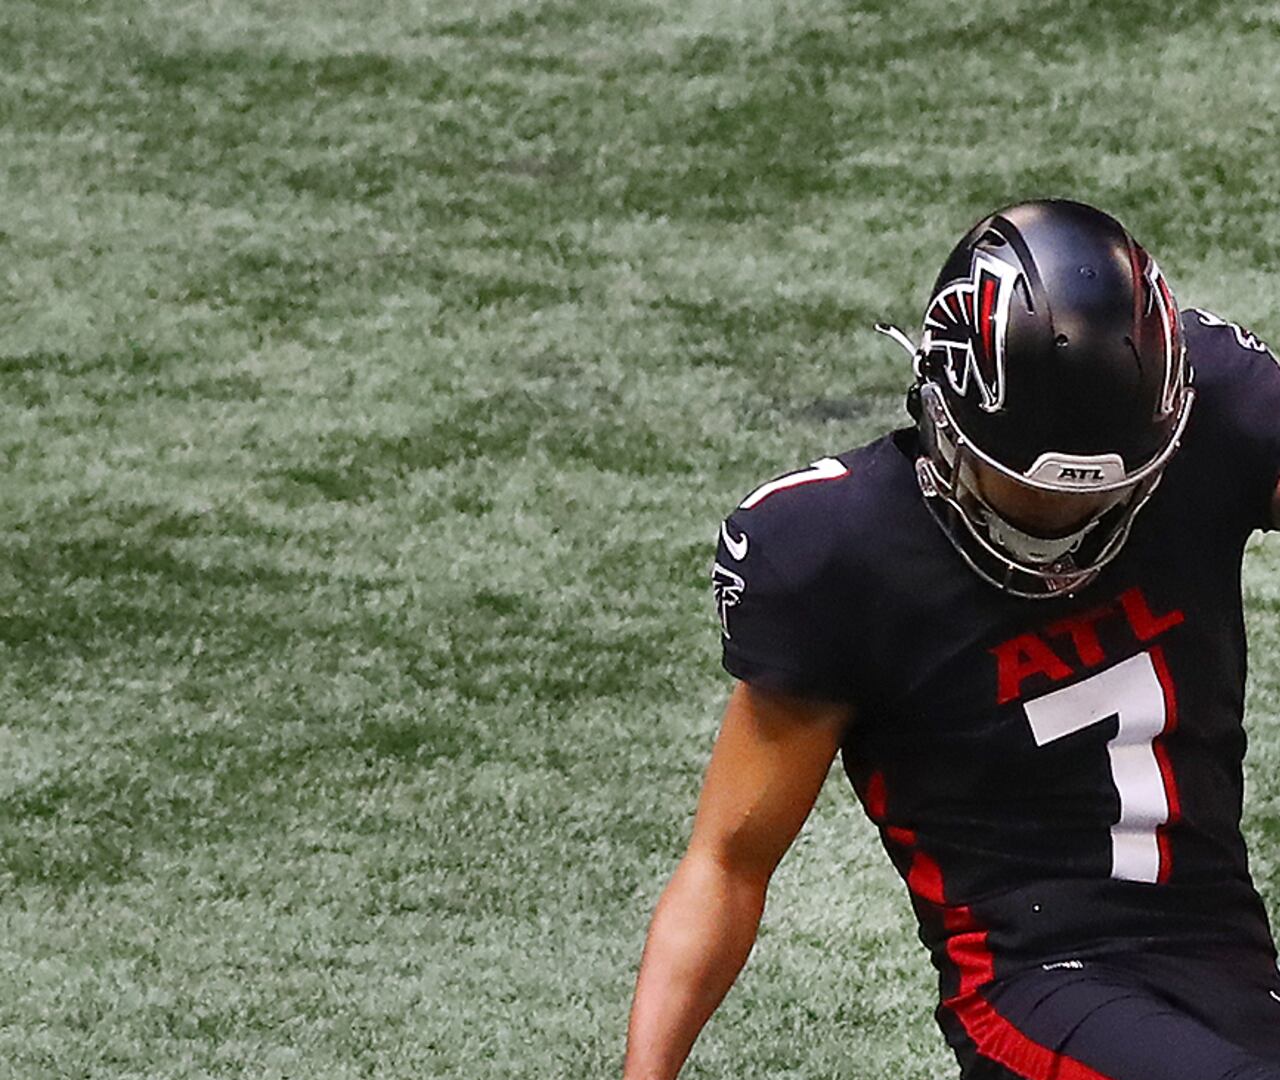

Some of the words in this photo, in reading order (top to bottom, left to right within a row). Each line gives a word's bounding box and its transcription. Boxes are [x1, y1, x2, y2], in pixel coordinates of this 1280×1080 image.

[1057, 467, 1105, 480] ATL
[987, 587, 1185, 704] ATL
[1023, 646, 1180, 884] 7
